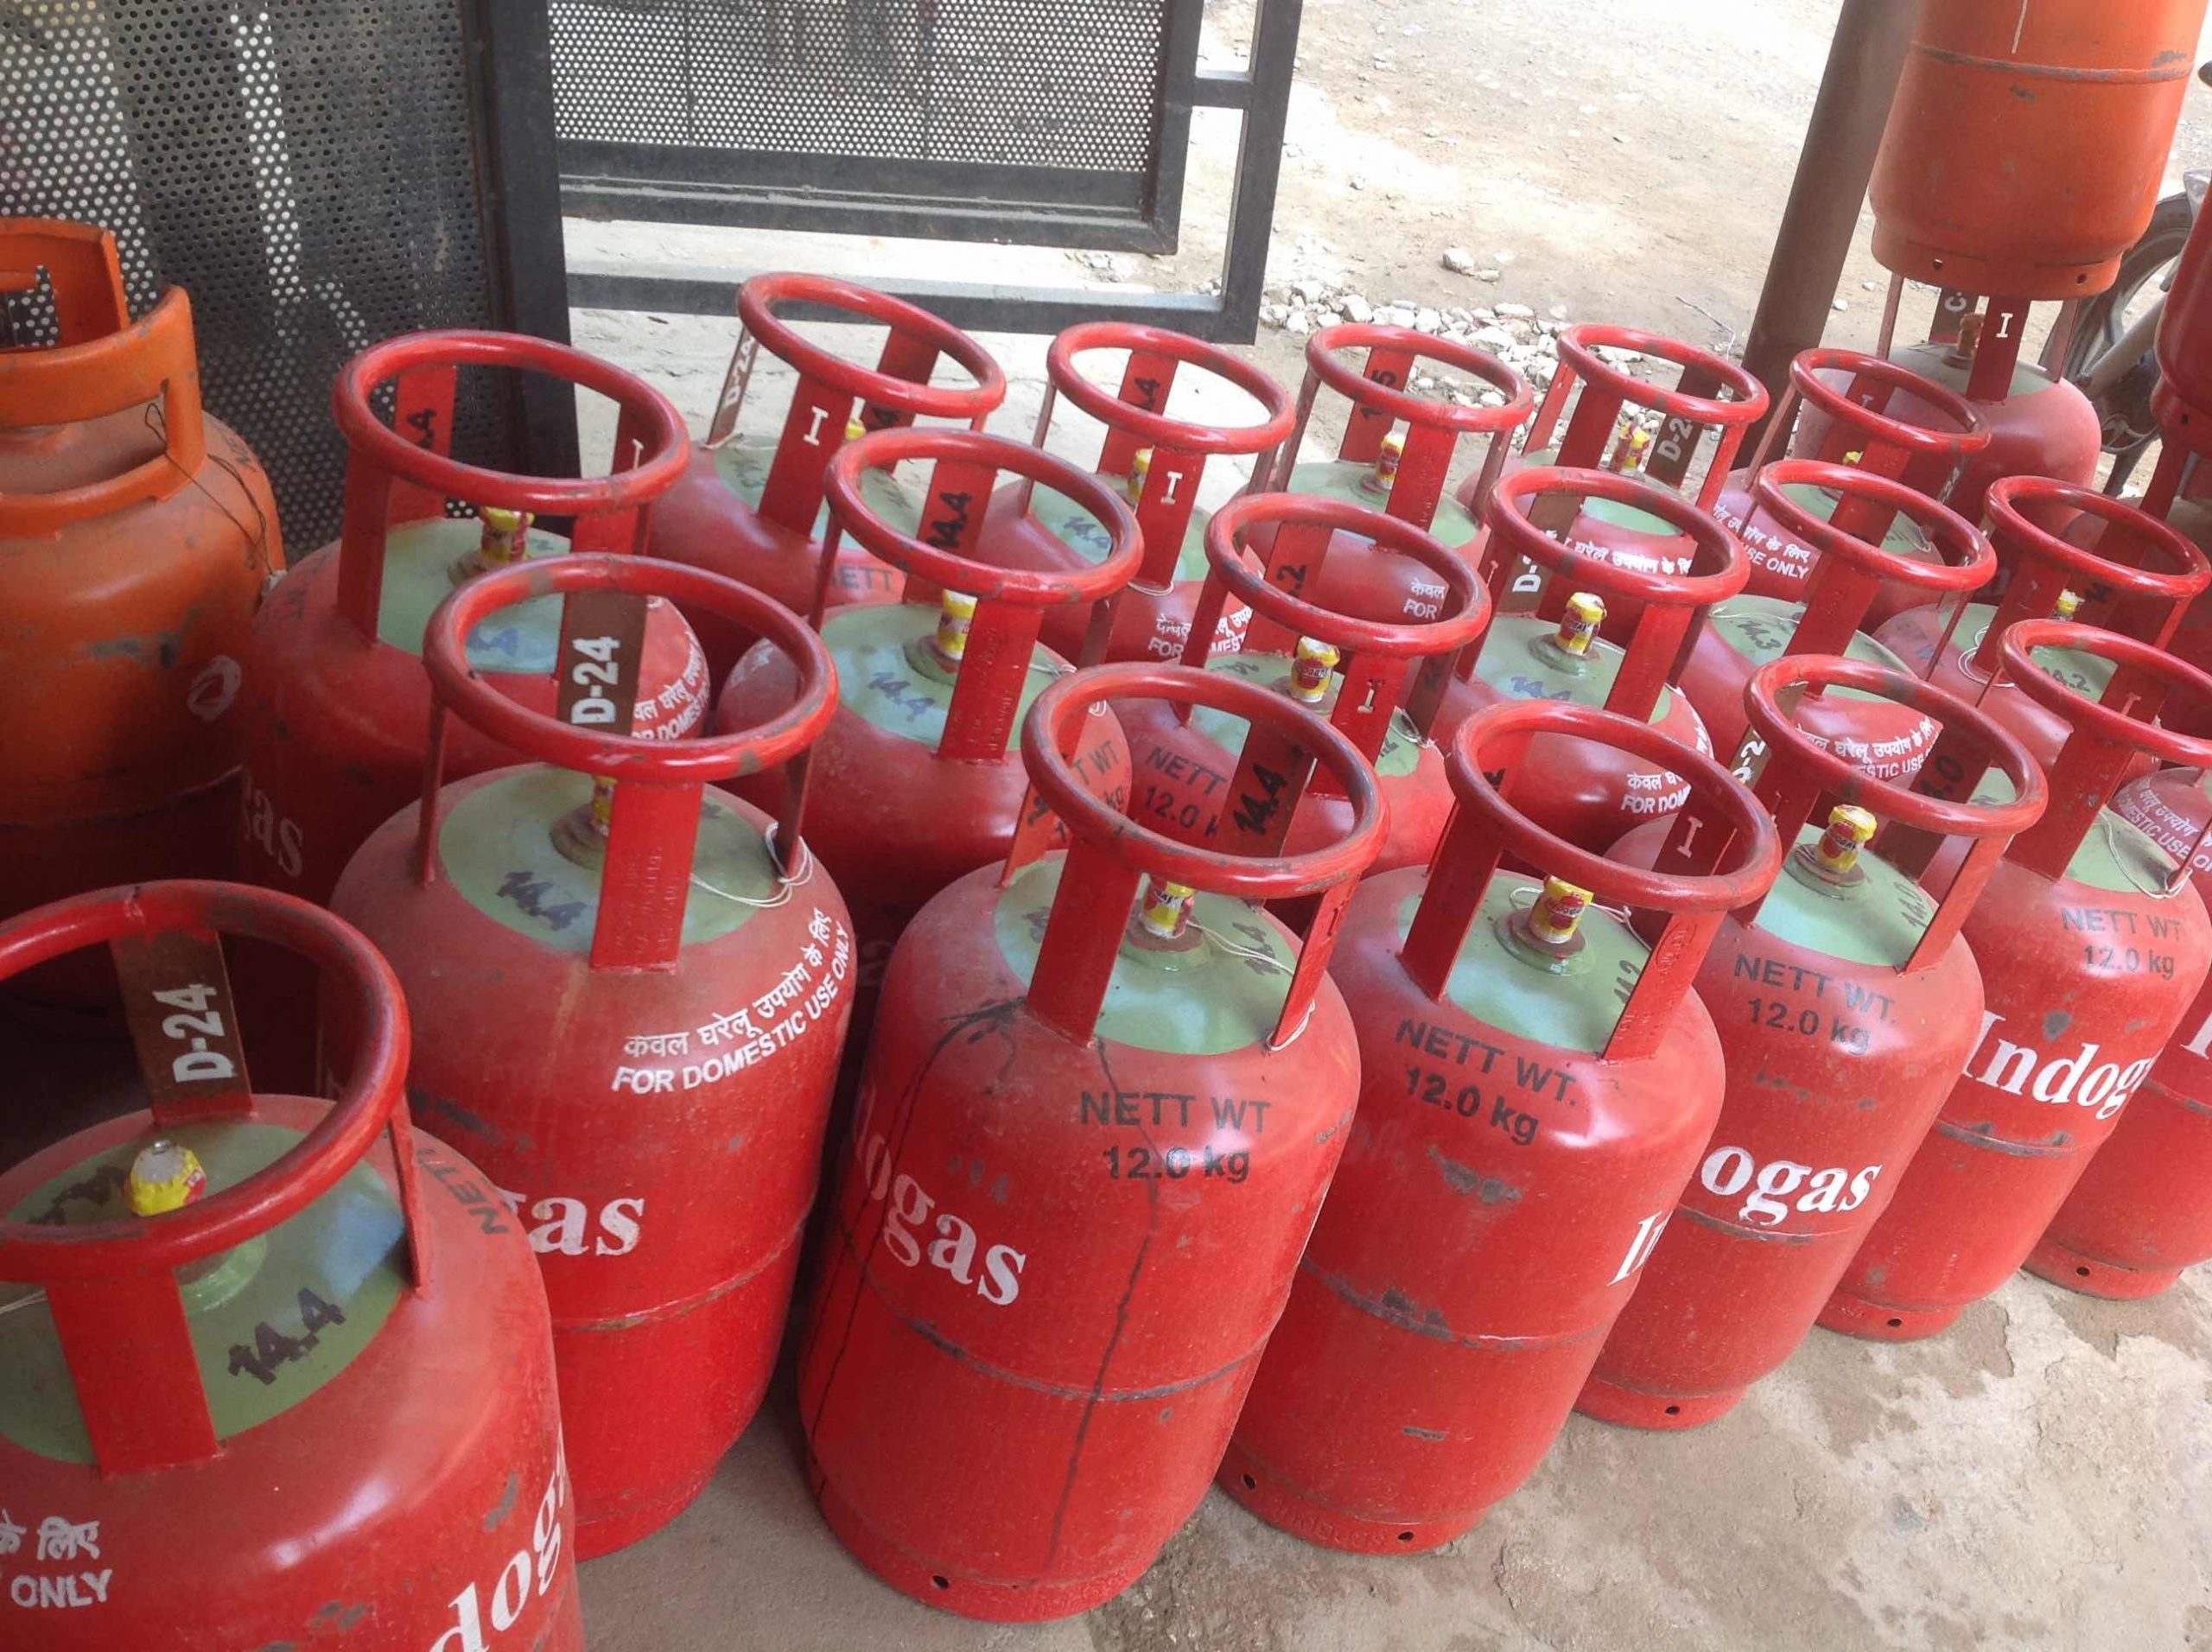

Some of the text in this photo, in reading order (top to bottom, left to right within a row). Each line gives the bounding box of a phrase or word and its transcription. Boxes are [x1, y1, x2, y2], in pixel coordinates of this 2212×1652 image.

[803, 405, 829, 446] I
[1656, 417, 1694, 463] D-2
[1160, 470, 1183, 505] I
[1742, 542, 1809, 580] SE ONLY
[1402, 598, 1438, 620] FOR
[1147, 636, 1185, 658] FOR
[570, 636, 621, 724] D-24
[1088, 740, 1121, 776] WT
[1145, 745, 1228, 797] NETT
[1730, 726, 1766, 785] D-2
[1620, 785, 1692, 814] FOR DOM
[1626, 772, 1662, 791] केवल
[249, 772, 303, 878] as
[1144, 785, 1221, 838] 12.0 k
[2158, 832, 2192, 860] USE
[808, 906, 833, 948] लिए
[2060, 906, 2183, 942] NETT WT
[800, 942, 823, 968] के
[2083, 944, 2175, 982] 12.0 kg
[611, 920, 851, 1095] FOR DOMESTIC USE ONLY
[752, 962, 812, 1019] उपयोग
[1733, 953, 1897, 1024] NETT WT.
[152, 982, 239, 1084] D-24
[696, 1012, 764, 1046] घरेलू
[1748, 997, 1871, 1057] 12.0 kg
[1395, 1018, 1577, 1107] NETT WT.
[1961, 1009, 2164, 1121] Indog
[1080, 1090, 1272, 1134] NETT WT
[1405, 1065, 1540, 1147] 12.0 kg
[1103, 1144, 1250, 1184] 12.0 kg
[1700, 1146, 1884, 1227] ogas
[499, 1186, 645, 1257] as
[860, 1110, 1027, 1306] ogas
[227, 1287, 347, 1386] 14.4
[35, 1515, 102, 1561] लिए
[428, 1421, 566, 1652] dog
[10, 1568, 114, 1609] ONLY
